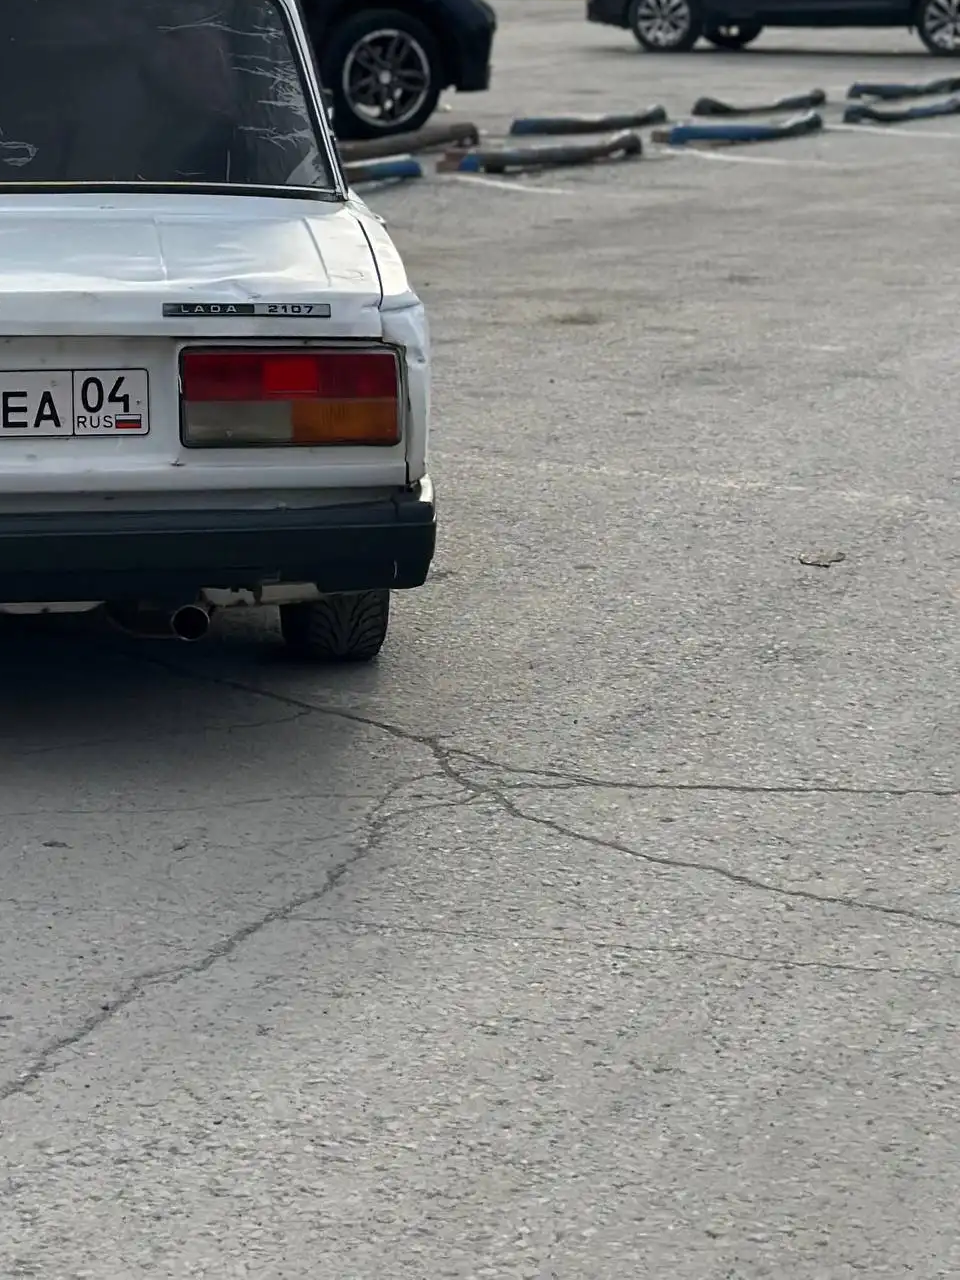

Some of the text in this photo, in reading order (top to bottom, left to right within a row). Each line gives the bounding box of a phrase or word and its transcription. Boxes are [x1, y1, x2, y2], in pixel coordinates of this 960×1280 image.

[180, 304, 314, 314] LADA 2107
[80, 376, 130, 413] 04
[76, 414, 114, 429] RUS
